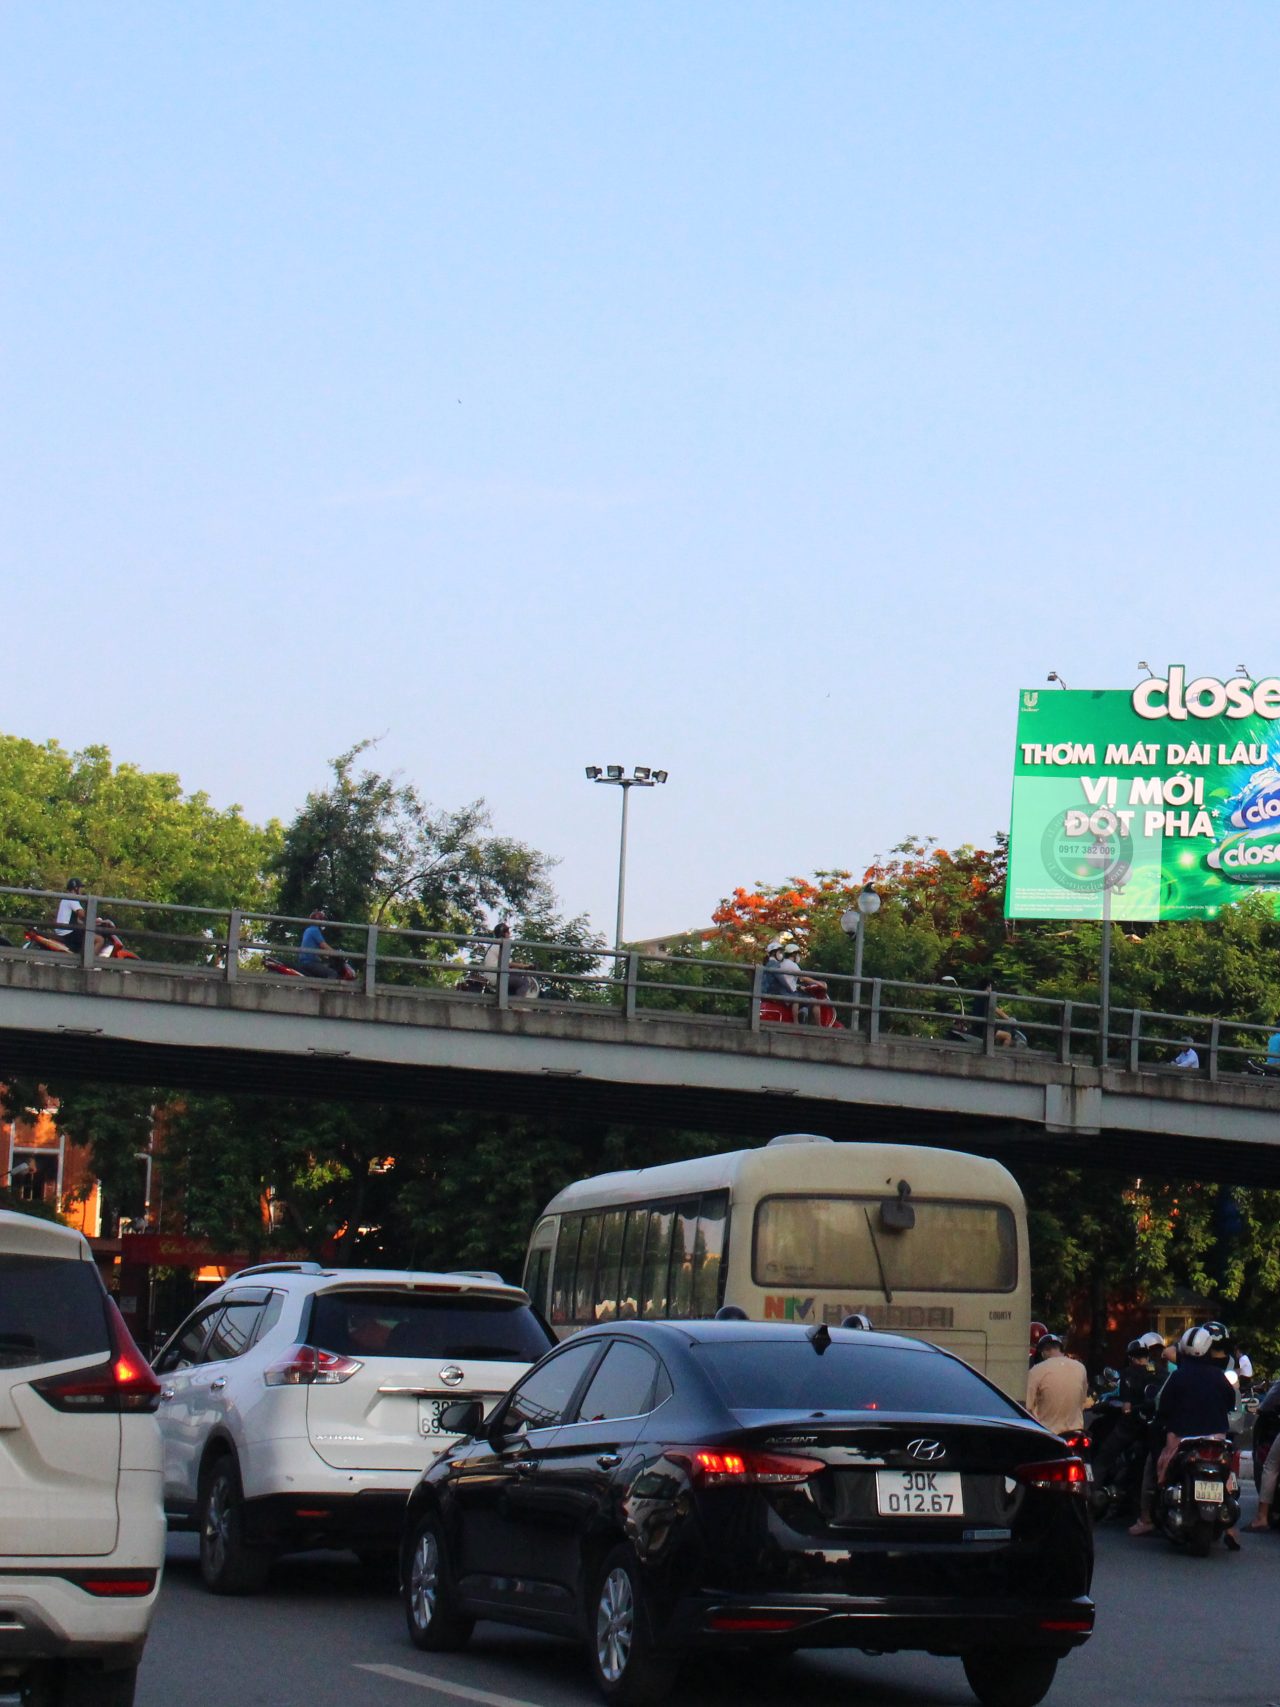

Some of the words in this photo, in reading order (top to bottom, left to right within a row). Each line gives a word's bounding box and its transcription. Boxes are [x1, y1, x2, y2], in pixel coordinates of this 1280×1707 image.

[1021, 741, 1096, 765] THƠM
[1104, 740, 1160, 765] MÁT
[1167, 740, 1211, 765] DÀI
[1218, 740, 1268, 765] LÂU
[1080, 776, 1118, 809] VỊ
[1128, 770, 1205, 806] MỚI
[765, 1436, 818, 1444] ACCENT
[903, 1471, 939, 1492] 30K
[888, 1493, 954, 1514] 012.67
